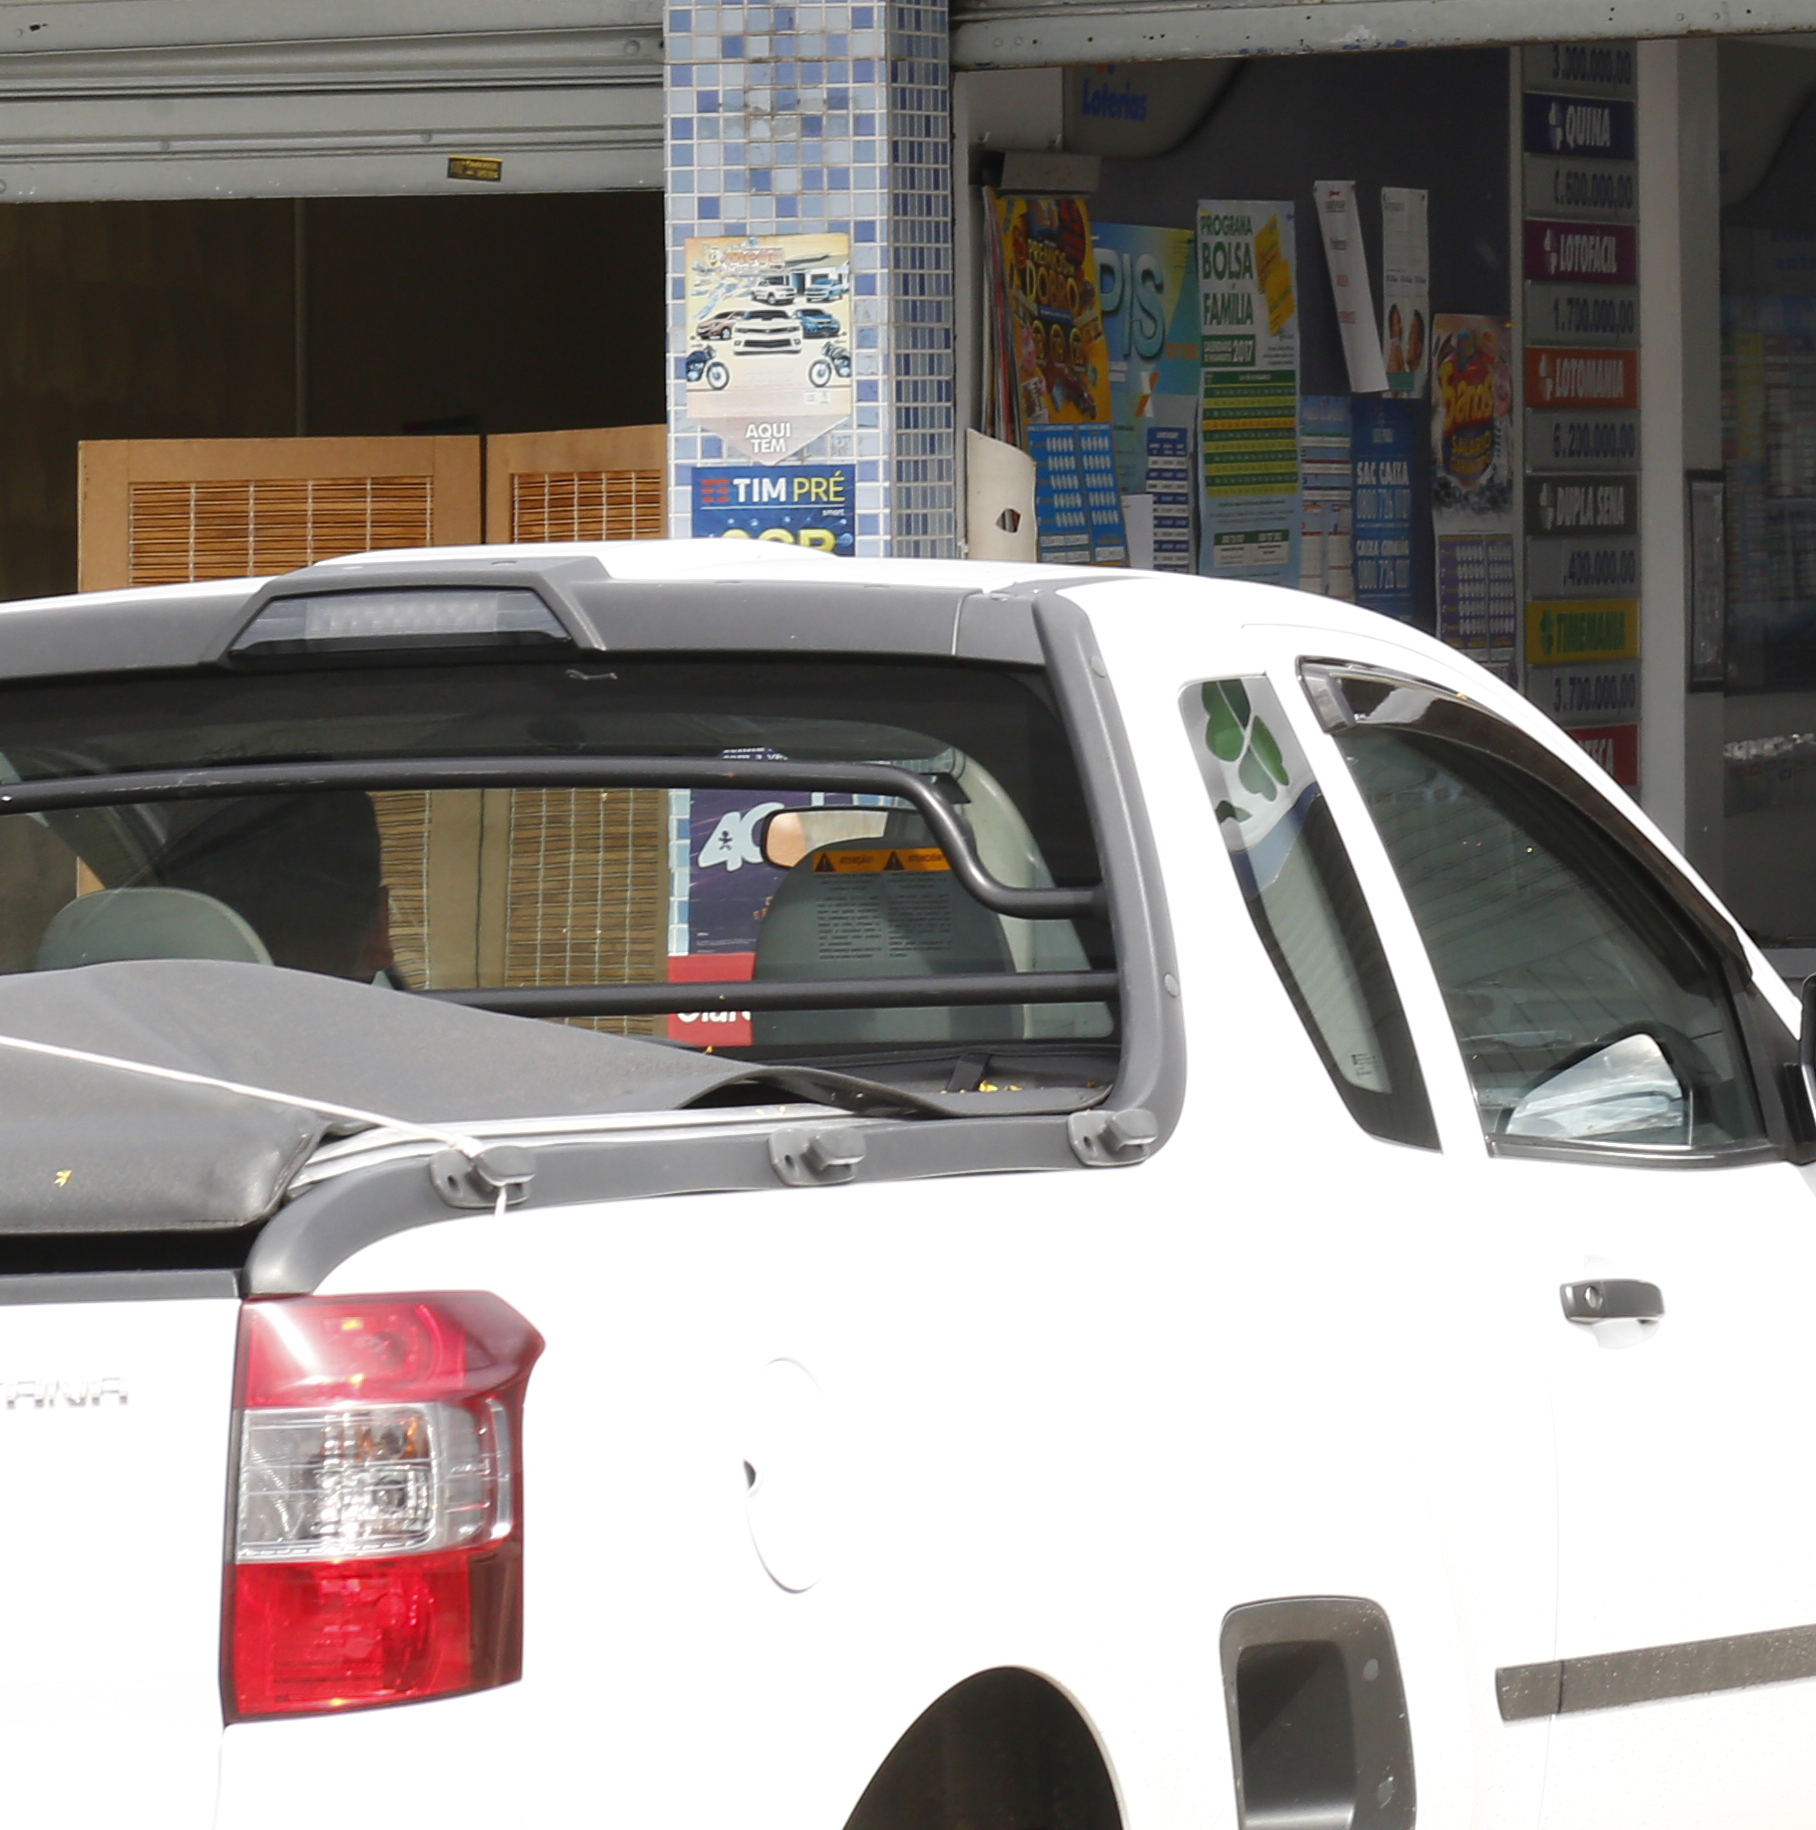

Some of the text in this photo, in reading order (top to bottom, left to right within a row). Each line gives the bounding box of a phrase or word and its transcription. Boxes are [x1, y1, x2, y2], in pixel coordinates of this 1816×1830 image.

[1081, 77, 1147, 122] Loterias
[1565, 104, 1612, 151] QUINA
[1200, 214, 1254, 237] PROGRAMA
[1201, 240, 1254, 282] BOLSA
[1559, 228, 1618, 275] LOTOFÁCIL
[1092, 247, 1166, 360] PIS
[1201, 282, 1255, 327] FAMÍLIA
[1555, 357, 1625, 399] LOTOMANIA
[744, 422, 791, 441] AQUI
[750, 437, 787, 454] TEM
[732, 470, 846, 503] TIM PRÉ
[1356, 460, 1411, 486] SAC CAIXA
[1556, 484, 1626, 527] DUPLA SENA
[1556, 610, 1626, 654] TIMEMANIA
[0, 1376, 129, 1409] ANA
